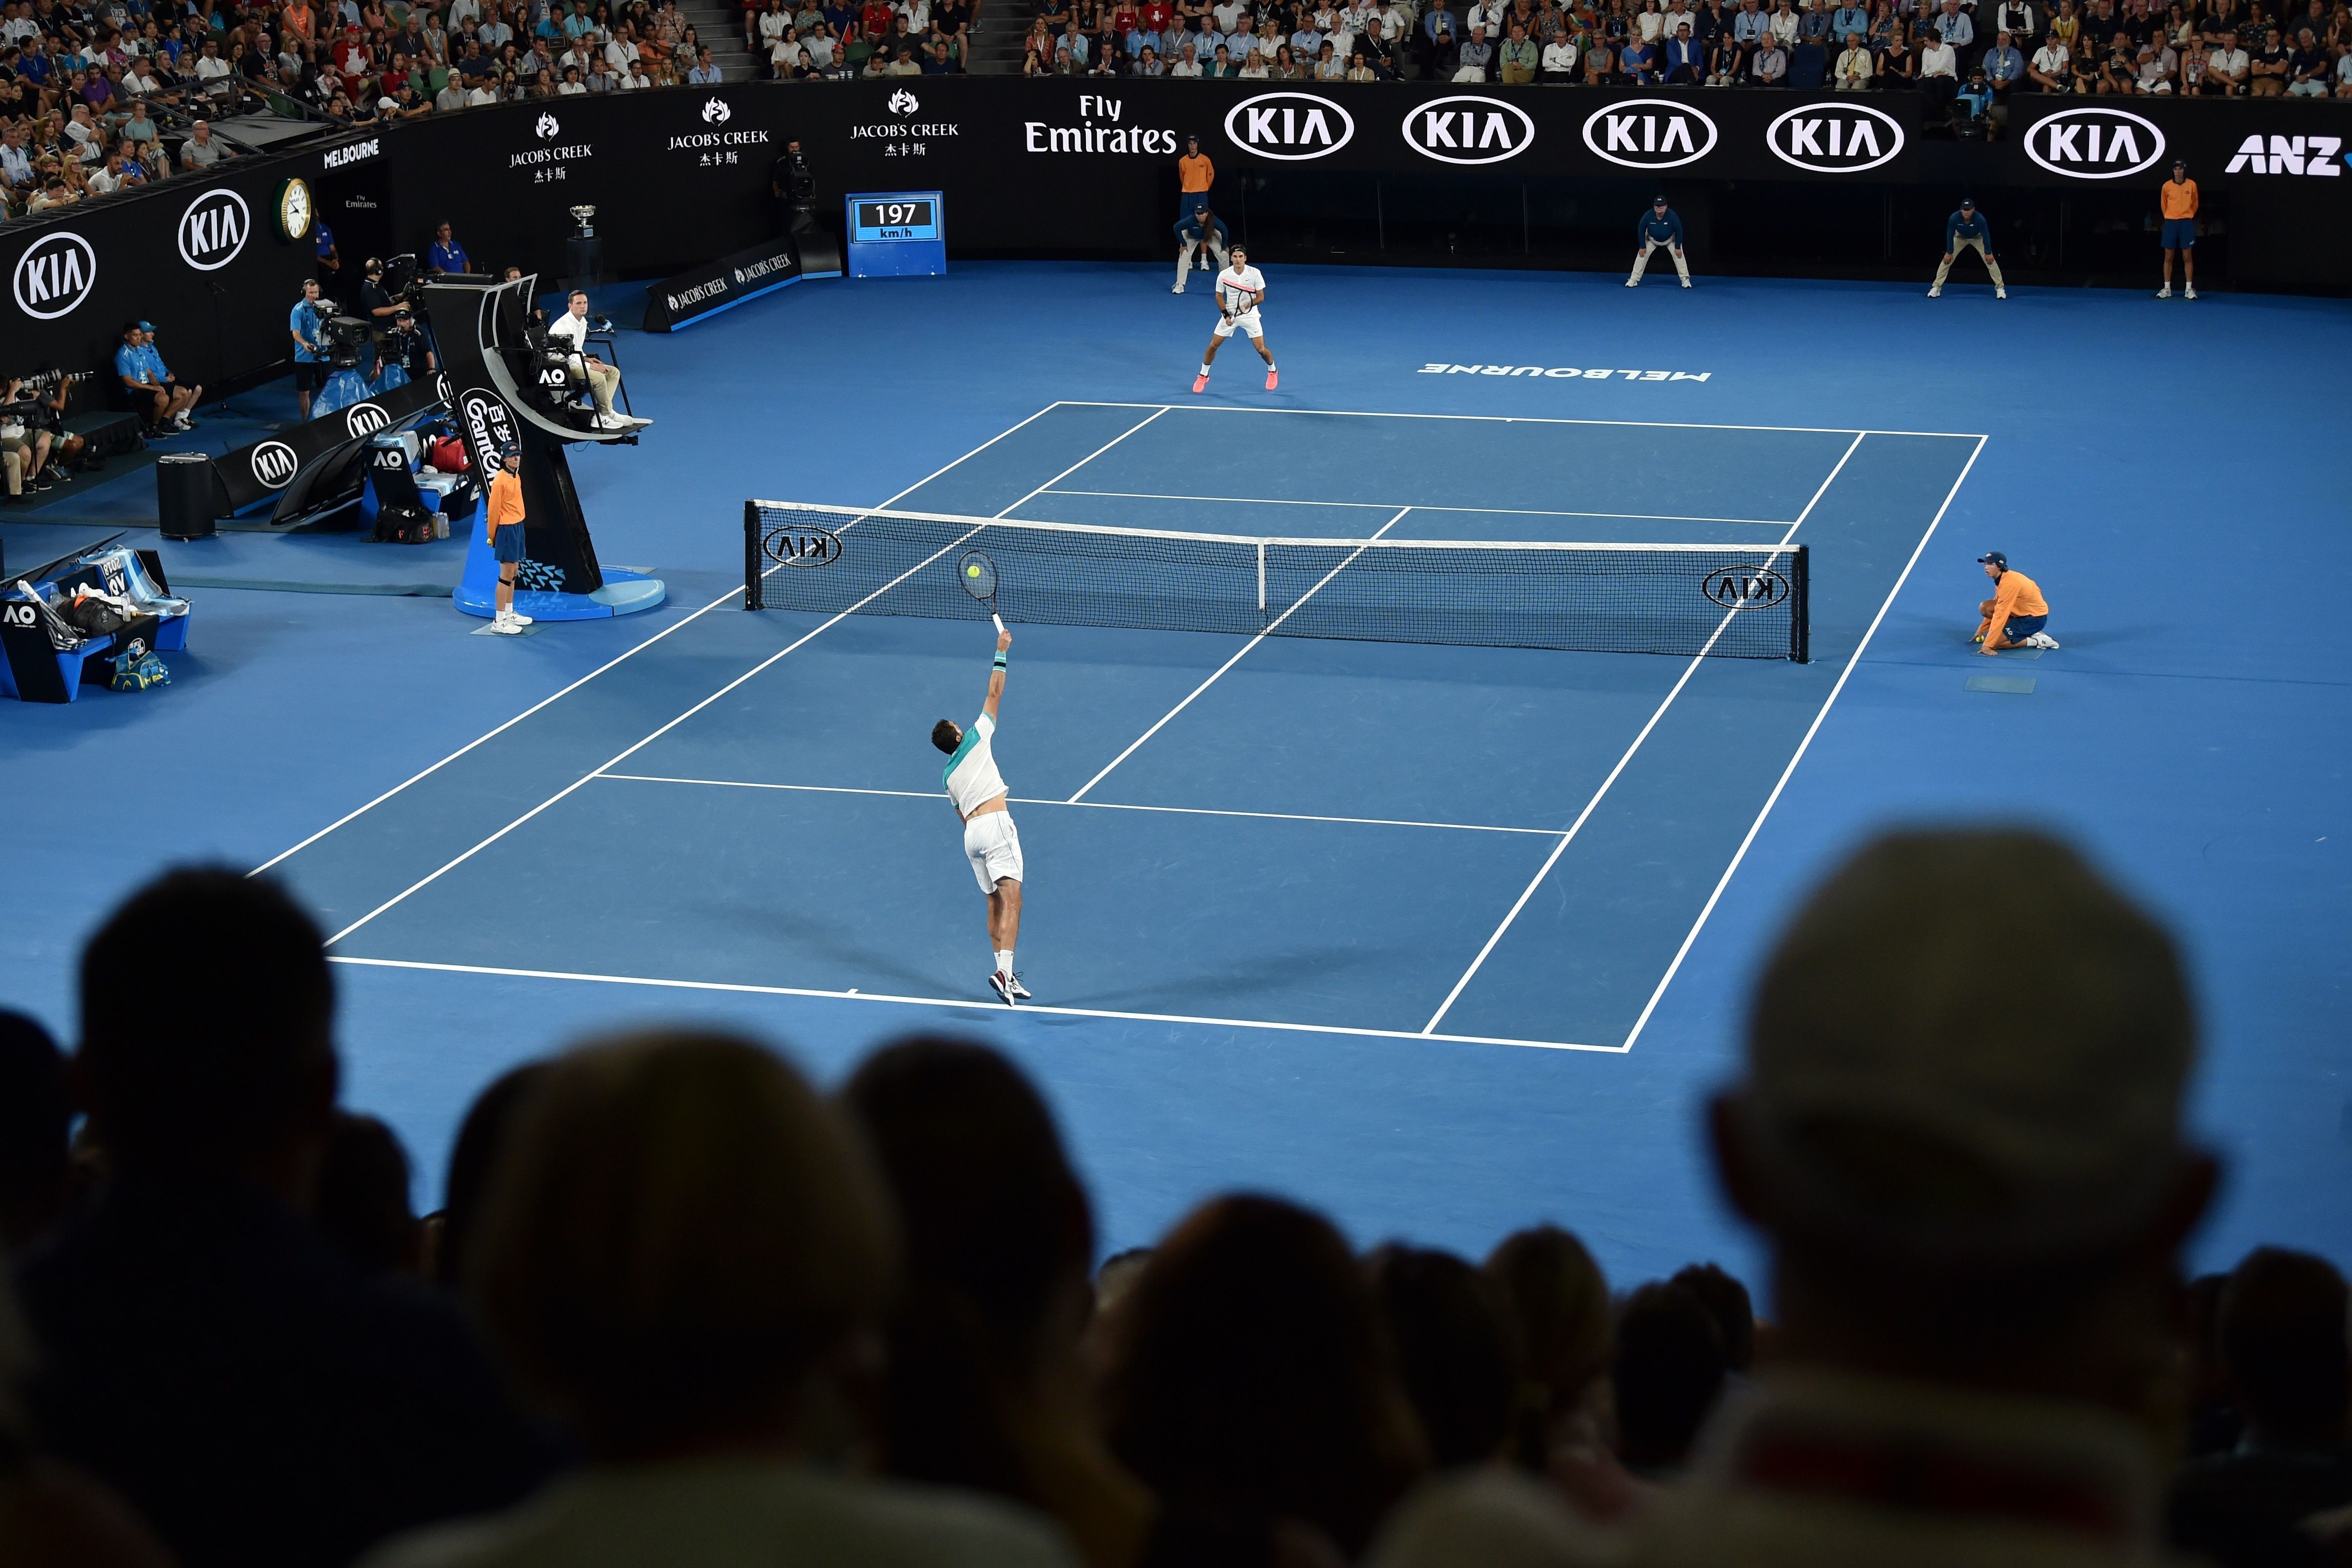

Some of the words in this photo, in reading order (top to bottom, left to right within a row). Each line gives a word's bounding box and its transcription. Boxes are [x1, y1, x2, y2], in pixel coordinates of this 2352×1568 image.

[1079, 95, 1122, 122] Fly
[850, 123, 907, 139] JACOB'S
[912, 124, 959, 136] CREEK
[1024, 121, 1176, 154] Emirates
[1247, 108, 1332, 145] KIA
[1425, 111, 1512, 149] KIA
[1606, 115, 1695, 152] KIA
[1790, 119, 1880, 157] KIA
[667, 132, 720, 150] JACOB'S
[724, 130, 768, 145] CREEK
[885, 142, 926, 156] 杰卡斯
[2049, 124, 2141, 163] KIA
[324, 138, 379, 169] MELBOURNE
[509, 148, 551, 168] JACOB'S
[553, 144, 592, 160] CREEK
[699, 151, 738, 167] 杰卡斯
[2224, 134, 2341, 176] ANZ
[534, 166, 566, 184] 杰卡斯
[346, 200, 377, 208] Emirates
[876, 204, 915, 224] 197
[190, 204, 239, 256] KIA
[880, 228, 913, 239] km/h
[26, 248, 84, 305] KIA
[744, 260, 770, 283] JACOB'S
[769, 253, 792, 271] CREEK
[678, 285, 705, 309] JACOB'S
[704, 277, 728, 297] CREEK
[539, 369, 565, 384] AO
[1416, 363, 1712, 382] MELBOURNE
[351, 410, 384, 436] KIA
[256, 449, 293, 481] KIA
[373, 451, 402, 467] AO
[103, 557, 121, 576] 2018
[3, 605, 36, 624] AO
[144, 674, 164, 685] HEA
